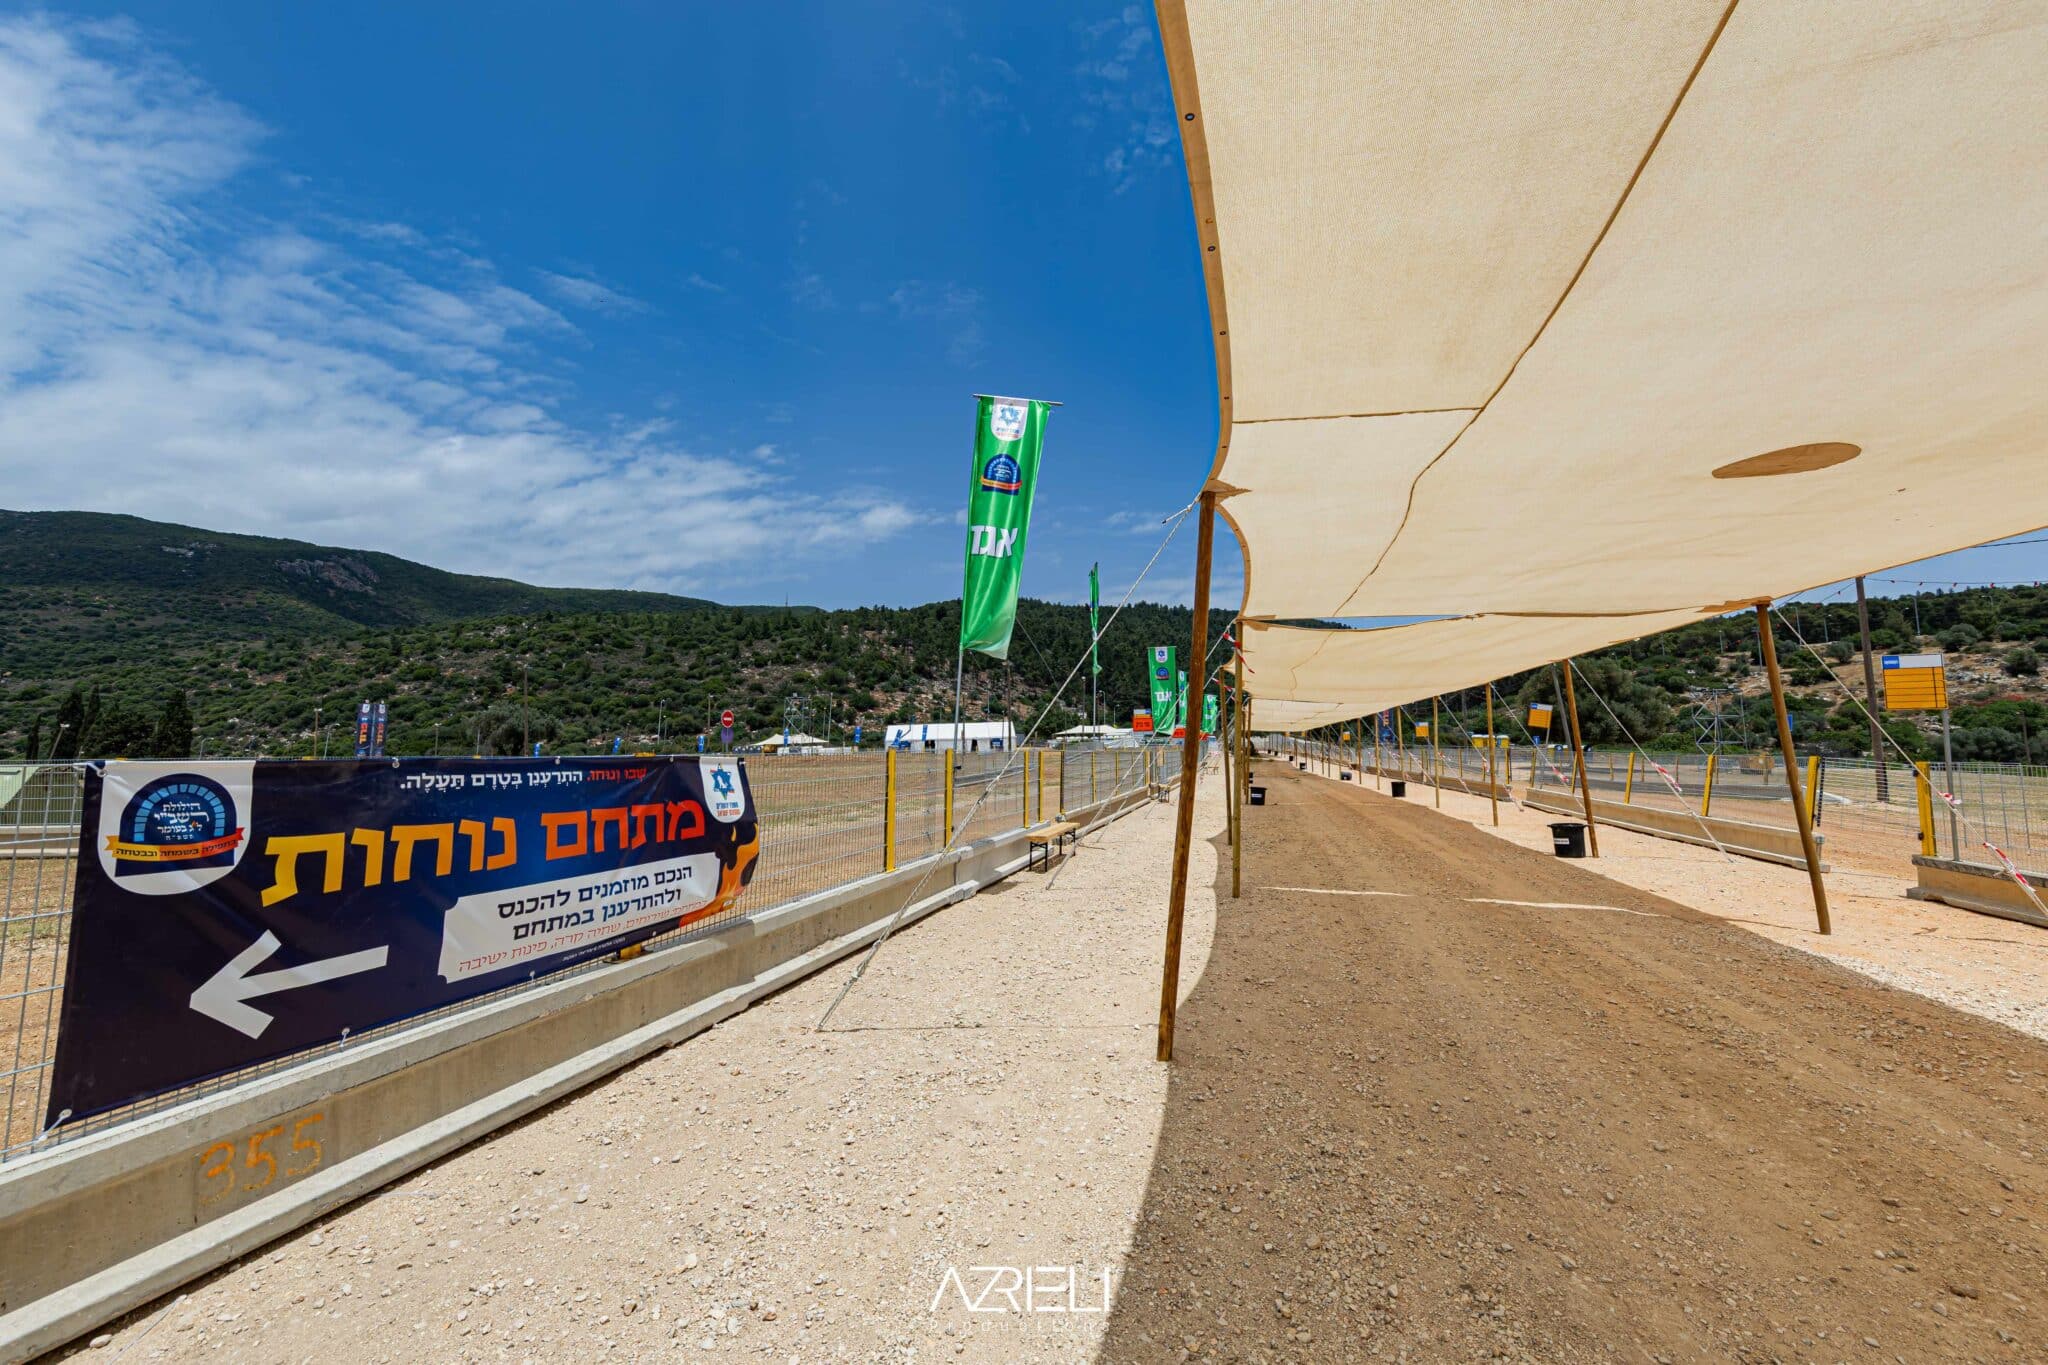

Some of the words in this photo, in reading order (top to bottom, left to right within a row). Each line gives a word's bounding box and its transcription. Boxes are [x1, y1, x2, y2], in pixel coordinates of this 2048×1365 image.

[971, 525, 1018, 558] אגד
[540, 799, 706, 862] מתחם
[115, 847, 158, 857] ובבטחה
[159, 847, 200, 858] בשמחה
[260, 816, 517, 908] נוחות
[578, 875, 650, 902] מוזמנים
[654, 865, 693, 886] הנכם
[497, 889, 572, 919] להכנס
[602, 887, 682, 922] ולהתרענן
[512, 908, 595, 941] במתחם
[587, 920, 621, 939] שתיה
[458, 951, 507, 973] ישיבה
[511, 941, 548, 960] פינות
[200, 1112, 325, 1204] 355
